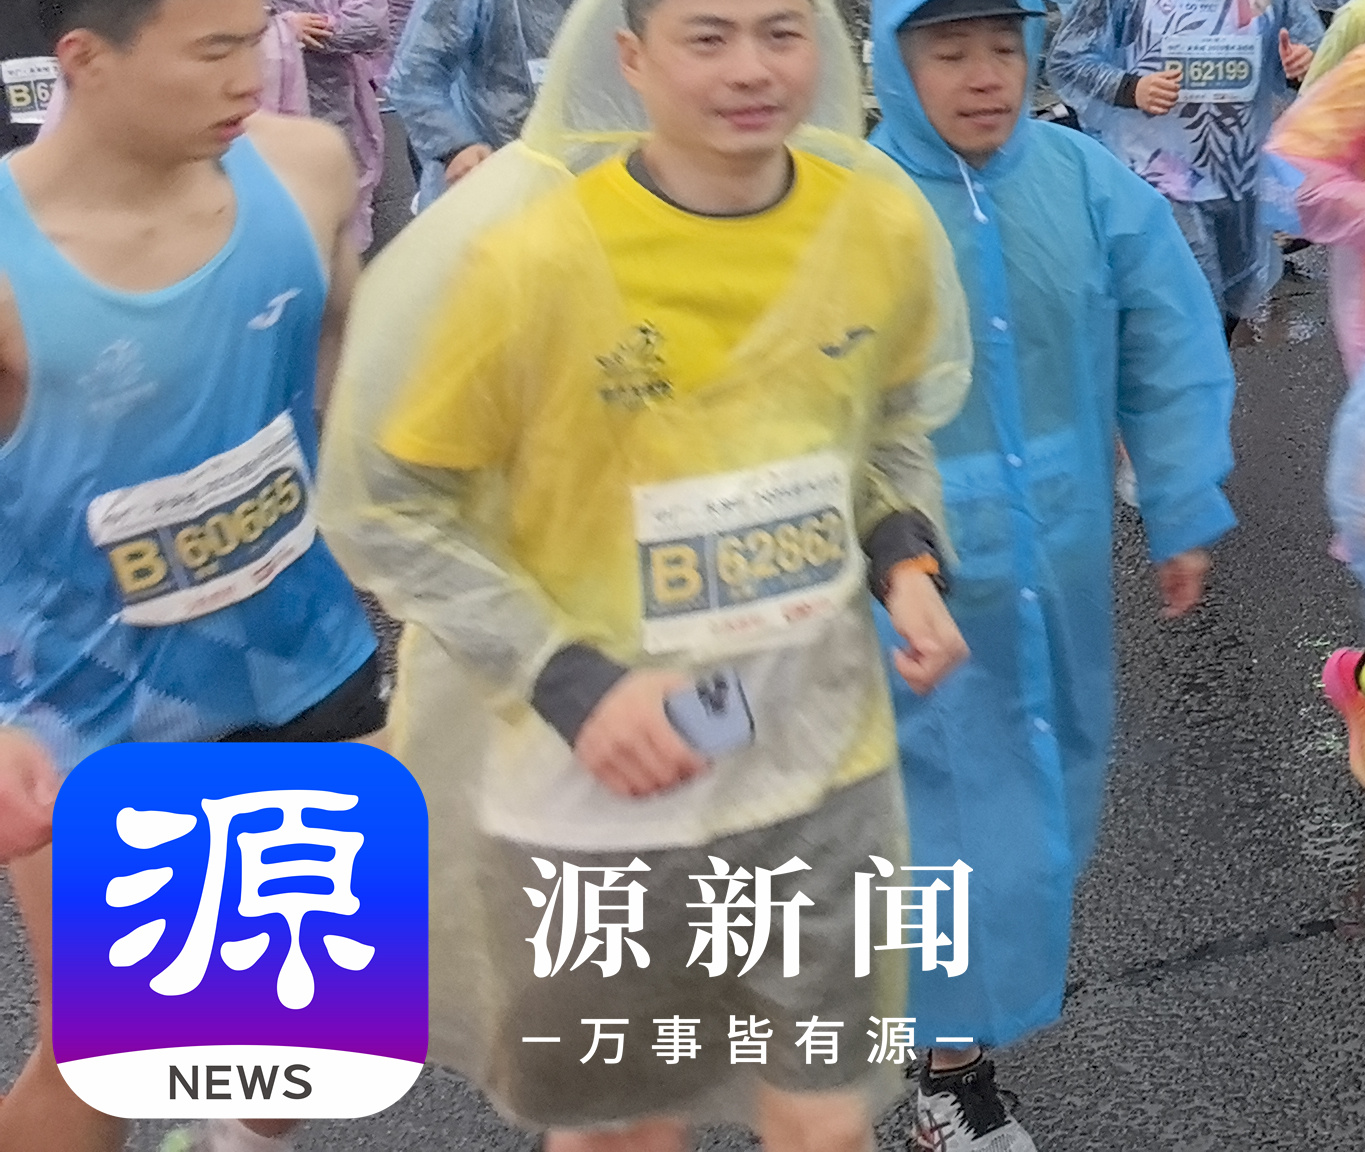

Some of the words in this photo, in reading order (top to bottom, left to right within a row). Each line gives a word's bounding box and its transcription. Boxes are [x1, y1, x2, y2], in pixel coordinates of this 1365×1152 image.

[1189, 60, 1250, 81] 62199
[9, 84, 32, 107] B
[108, 539, 168, 594] B
[652, 544, 703, 605] B
